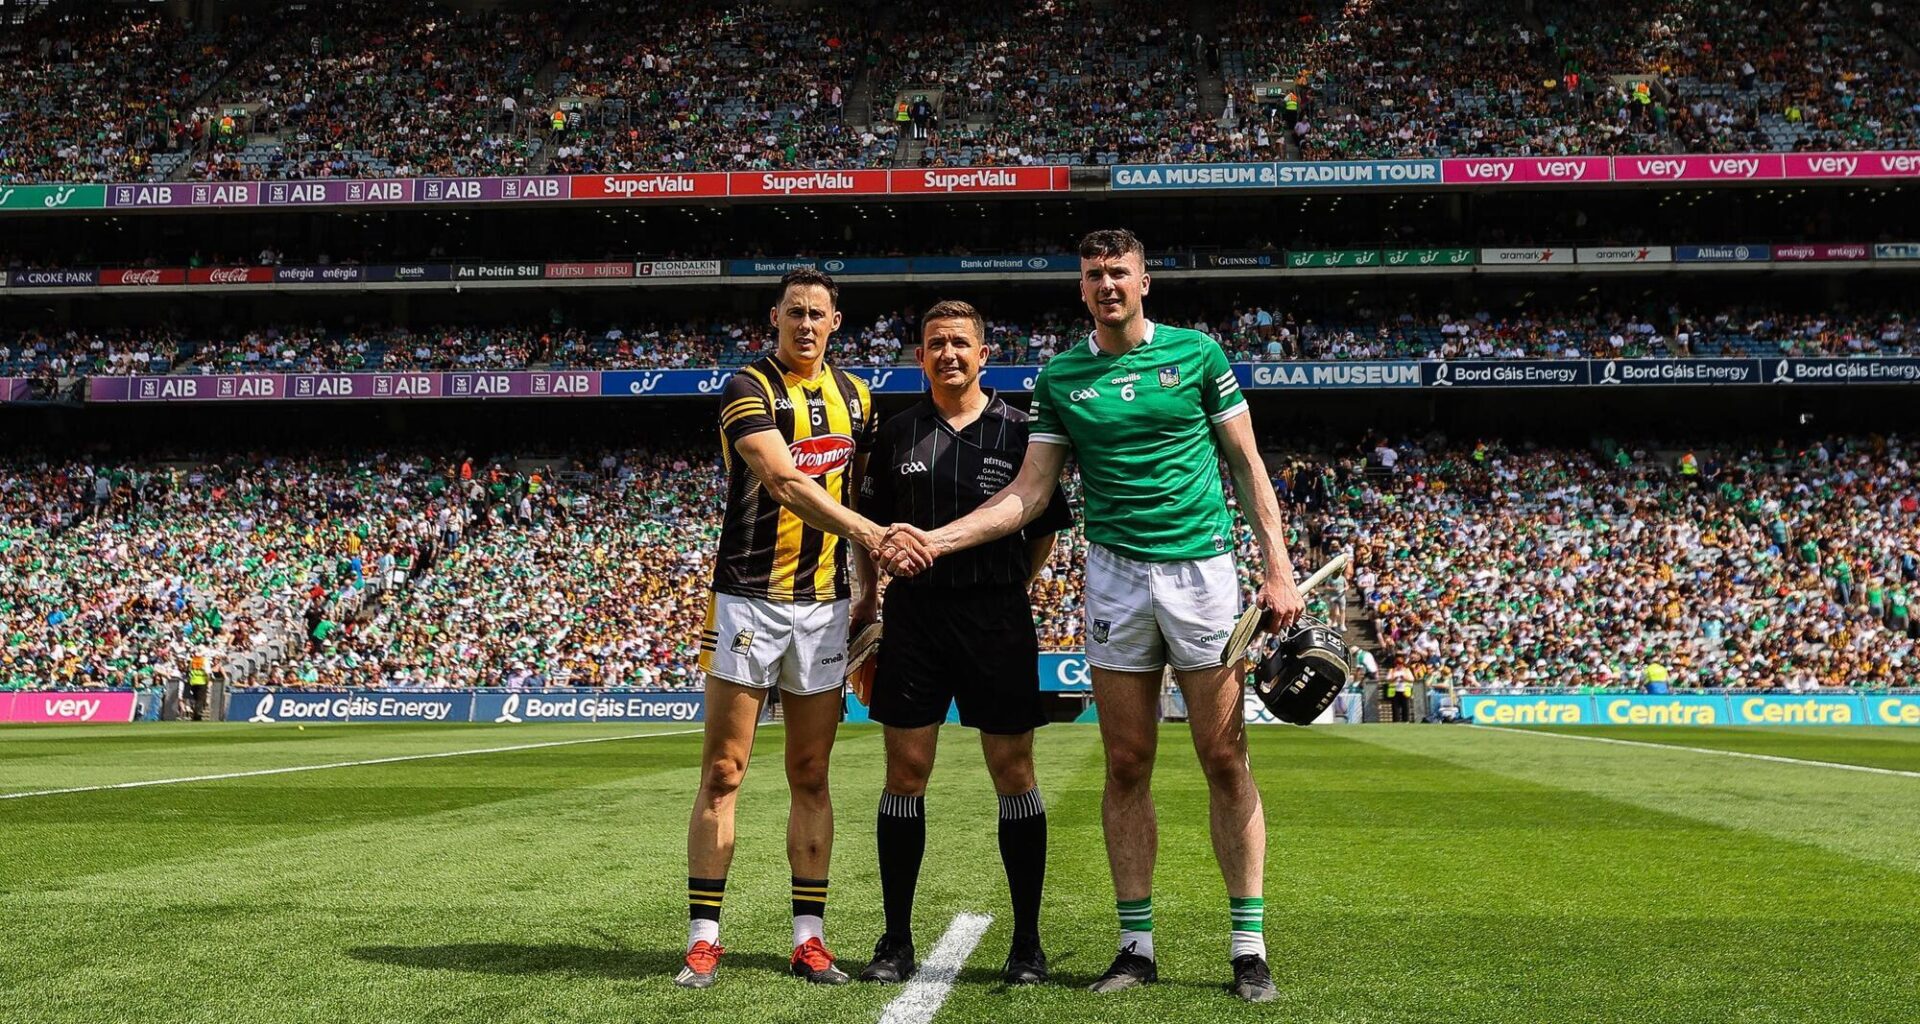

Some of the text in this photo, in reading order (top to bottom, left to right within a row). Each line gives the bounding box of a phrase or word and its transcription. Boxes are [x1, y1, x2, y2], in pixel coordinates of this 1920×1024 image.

[1116, 164, 1435, 185] GAA MUSEUM & STADIUM TOUR
[1466, 162, 1514, 181] very
[1537, 161, 1586, 180] very
[1637, 159, 1686, 179] very
[1710, 158, 1759, 178] very
[1808, 156, 1858, 177] very
[523, 180, 560, 197] AIB
[604, 176, 694, 198] SuperValu
[763, 173, 854, 194] SuperValu
[924, 170, 1016, 192] SuperValu
[44, 187, 76, 207] eir
[137, 187, 172, 204] AIB
[213, 186, 248, 203] AIB
[290, 185, 326, 202] AIB
[367, 183, 403, 200] AIB
[445, 182, 482, 199] AIB
[1500, 250, 1540, 260] aramark
[1596, 249, 1636, 258] aramark
[1697, 246, 1734, 258] Allianz
[655, 261, 717, 270] CLONDALKIN
[754, 263, 776, 271] Bank
[961, 259, 1023, 268] Bank of Ireland
[1218, 256, 1258, 266] GUINNESS
[28, 272, 92, 284] CROKE PARK
[400, 266, 425, 275] Bostik
[458, 265, 539, 276] An Poitín Stil
[551, 265, 584, 277] FUJITSU
[594, 264, 628, 276] FUJITSU
[1111, 373, 1141, 385] oneills
[1254, 366, 1420, 385] GAA MUSEUM
[1455, 366, 1577, 382] Bord Gáis Energy
[1623, 364, 1749, 380] Bord Gáis Energy
[1795, 364, 1833, 378] Bord
[1835, 363, 1868, 378] Gáis
[161, 380, 197, 397] AIB
[238, 379, 274, 396] AIB
[317, 378, 353, 395] AIB
[395, 377, 431, 394] AIB
[474, 376, 511, 394] AIB
[553, 375, 590, 393] AIB
[630, 371, 663, 394] eir
[1121, 384, 1135, 402] 6
[811, 408, 823, 426] 6
[1200, 629, 1230, 644] oneills
[45, 700, 100, 721] very
[279, 697, 452, 720] Bord Gáis Energy
[525, 698, 700, 720] Bord Gáis Energy
[1474, 699, 1581, 724] Centra
[1608, 699, 1715, 724] Centra
[1742, 698, 1851, 723] Centra
